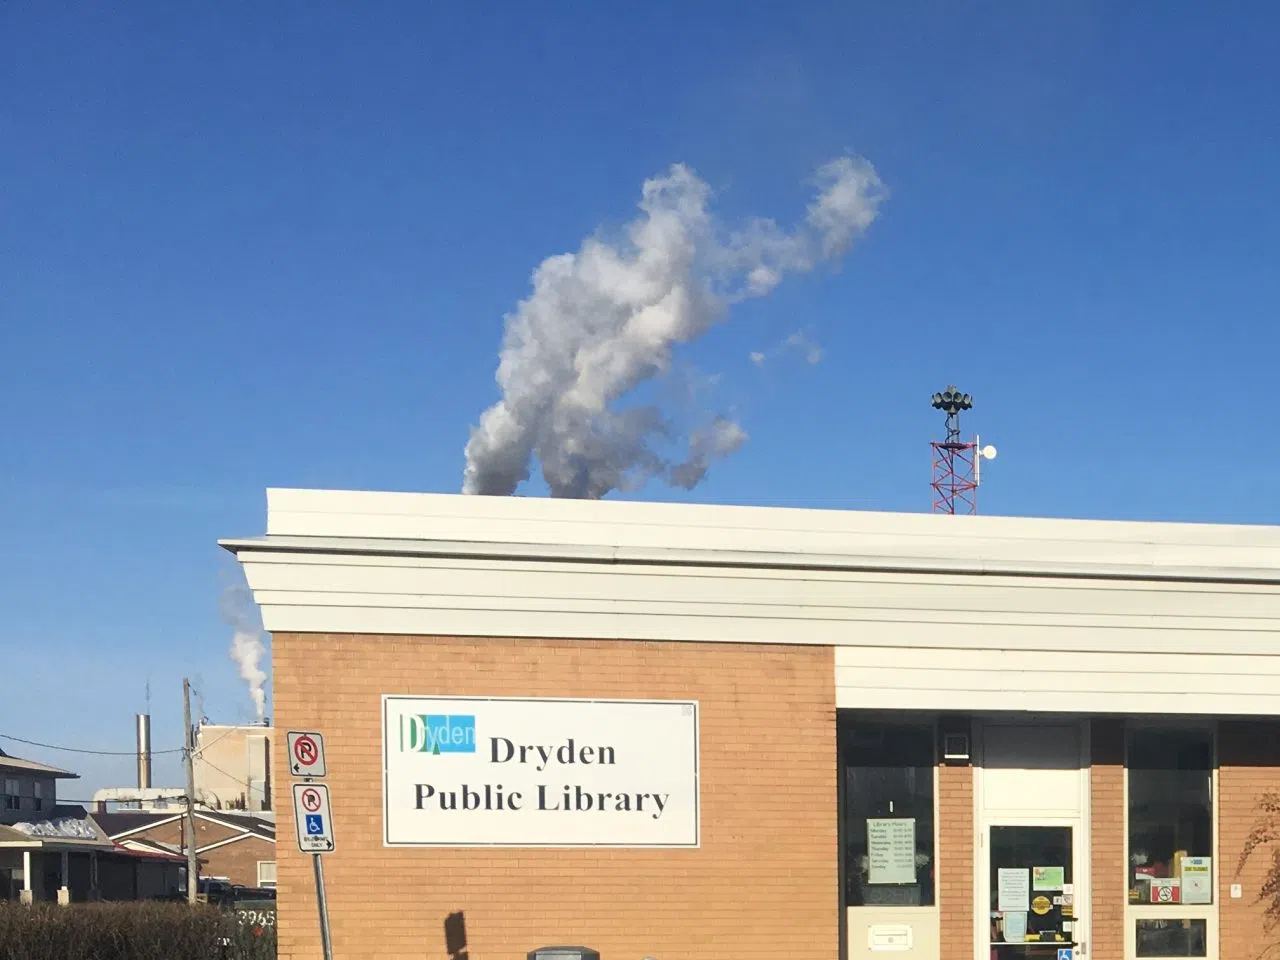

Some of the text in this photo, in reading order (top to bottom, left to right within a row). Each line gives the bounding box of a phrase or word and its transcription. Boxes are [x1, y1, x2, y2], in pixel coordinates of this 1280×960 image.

[401, 714, 475, 753] Dryden
[489, 737, 616, 772] Dryden
[413, 783, 671, 819] Public Library
